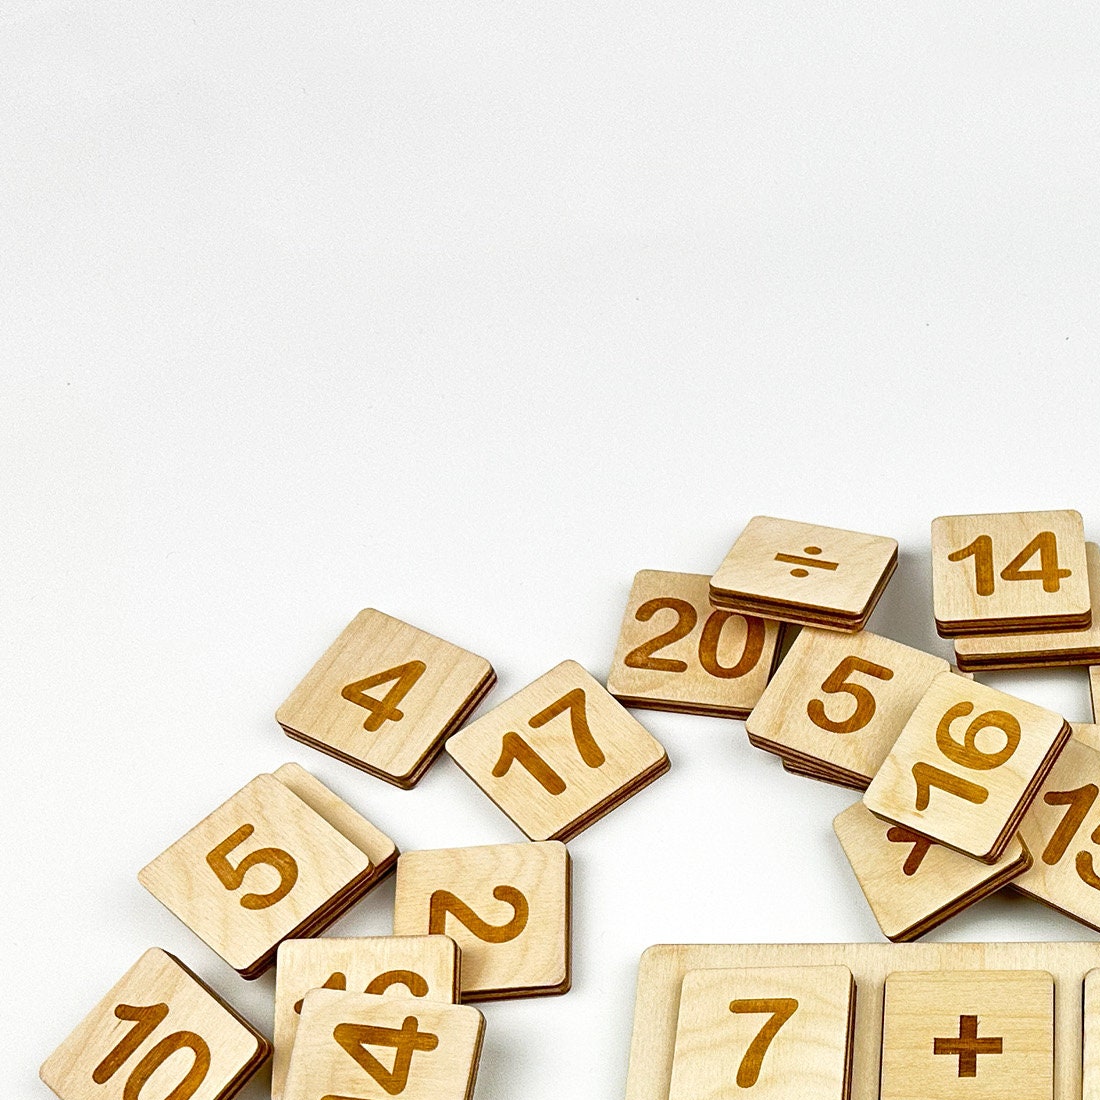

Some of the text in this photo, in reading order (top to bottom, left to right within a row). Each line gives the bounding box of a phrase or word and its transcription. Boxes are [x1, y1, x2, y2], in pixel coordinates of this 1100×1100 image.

[948, 531, 1072, 597] 14
[624, 597, 766, 679] 20
[341, 660, 426, 731] 4
[807, 656, 893, 733] 5
[492, 687, 606, 795] 17
[911, 701, 1021, 812] 16
[206, 824, 299, 910] 5
[429, 885, 529, 943] 2
[729, 997, 799, 1088] 7
